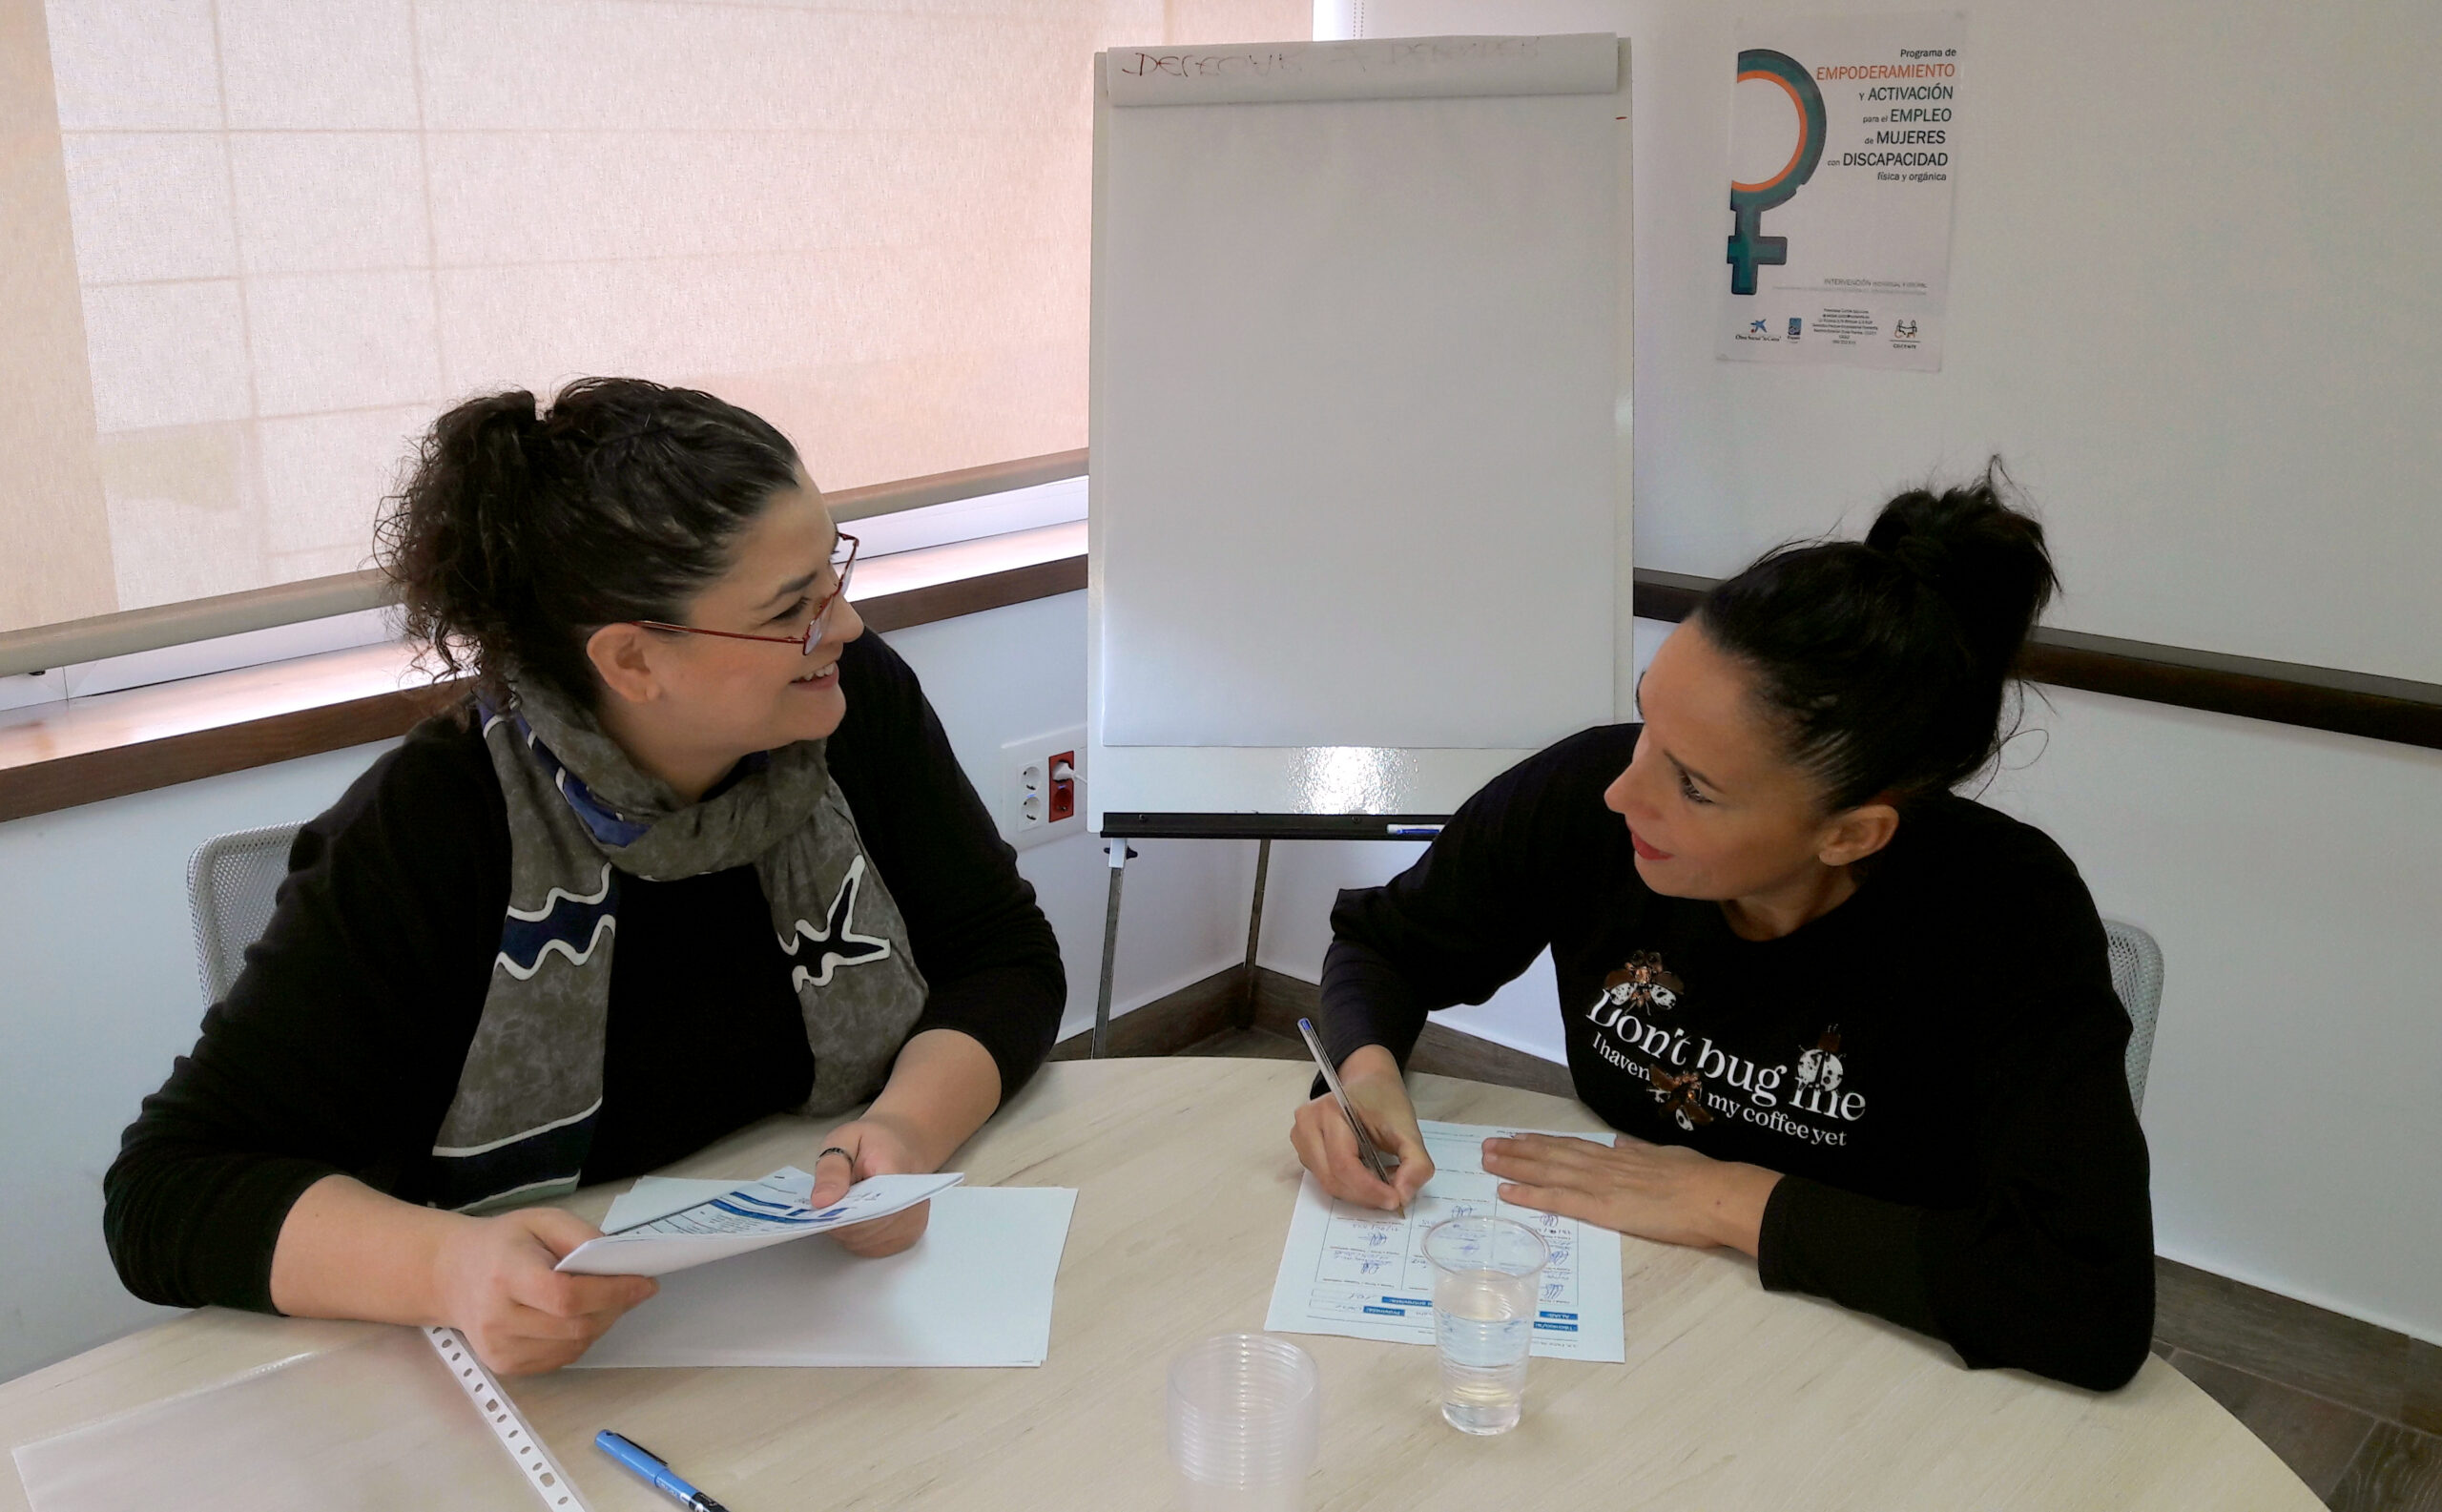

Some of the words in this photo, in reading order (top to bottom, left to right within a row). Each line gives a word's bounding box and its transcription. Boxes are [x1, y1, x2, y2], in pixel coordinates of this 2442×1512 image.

[1900, 49, 1943, 60] Programa
[1944, 48, 1957, 57] de
[1816, 63, 1956, 81] EMPODERAMIENTO
[1868, 83, 1954, 101] ACTIVACIÓN
[1862, 114, 1879, 125] para
[1880, 114, 1889, 123] el
[1890, 108, 1952, 123] EMPLEO
[1864, 135, 1874, 145] de
[1876, 130, 1946, 145] MUJERES
[1843, 153, 1949, 167] DISCAPACIDAD
[1877, 171, 1900, 182] física
[1901, 174, 1908, 183] y
[1909, 171, 1947, 182] orgánica
[1696, 1038, 1788, 1108] bug
[1707, 1091, 1741, 1119] my
[1743, 1108, 1810, 1139] coffee
[1811, 1128, 1847, 1147] yet
